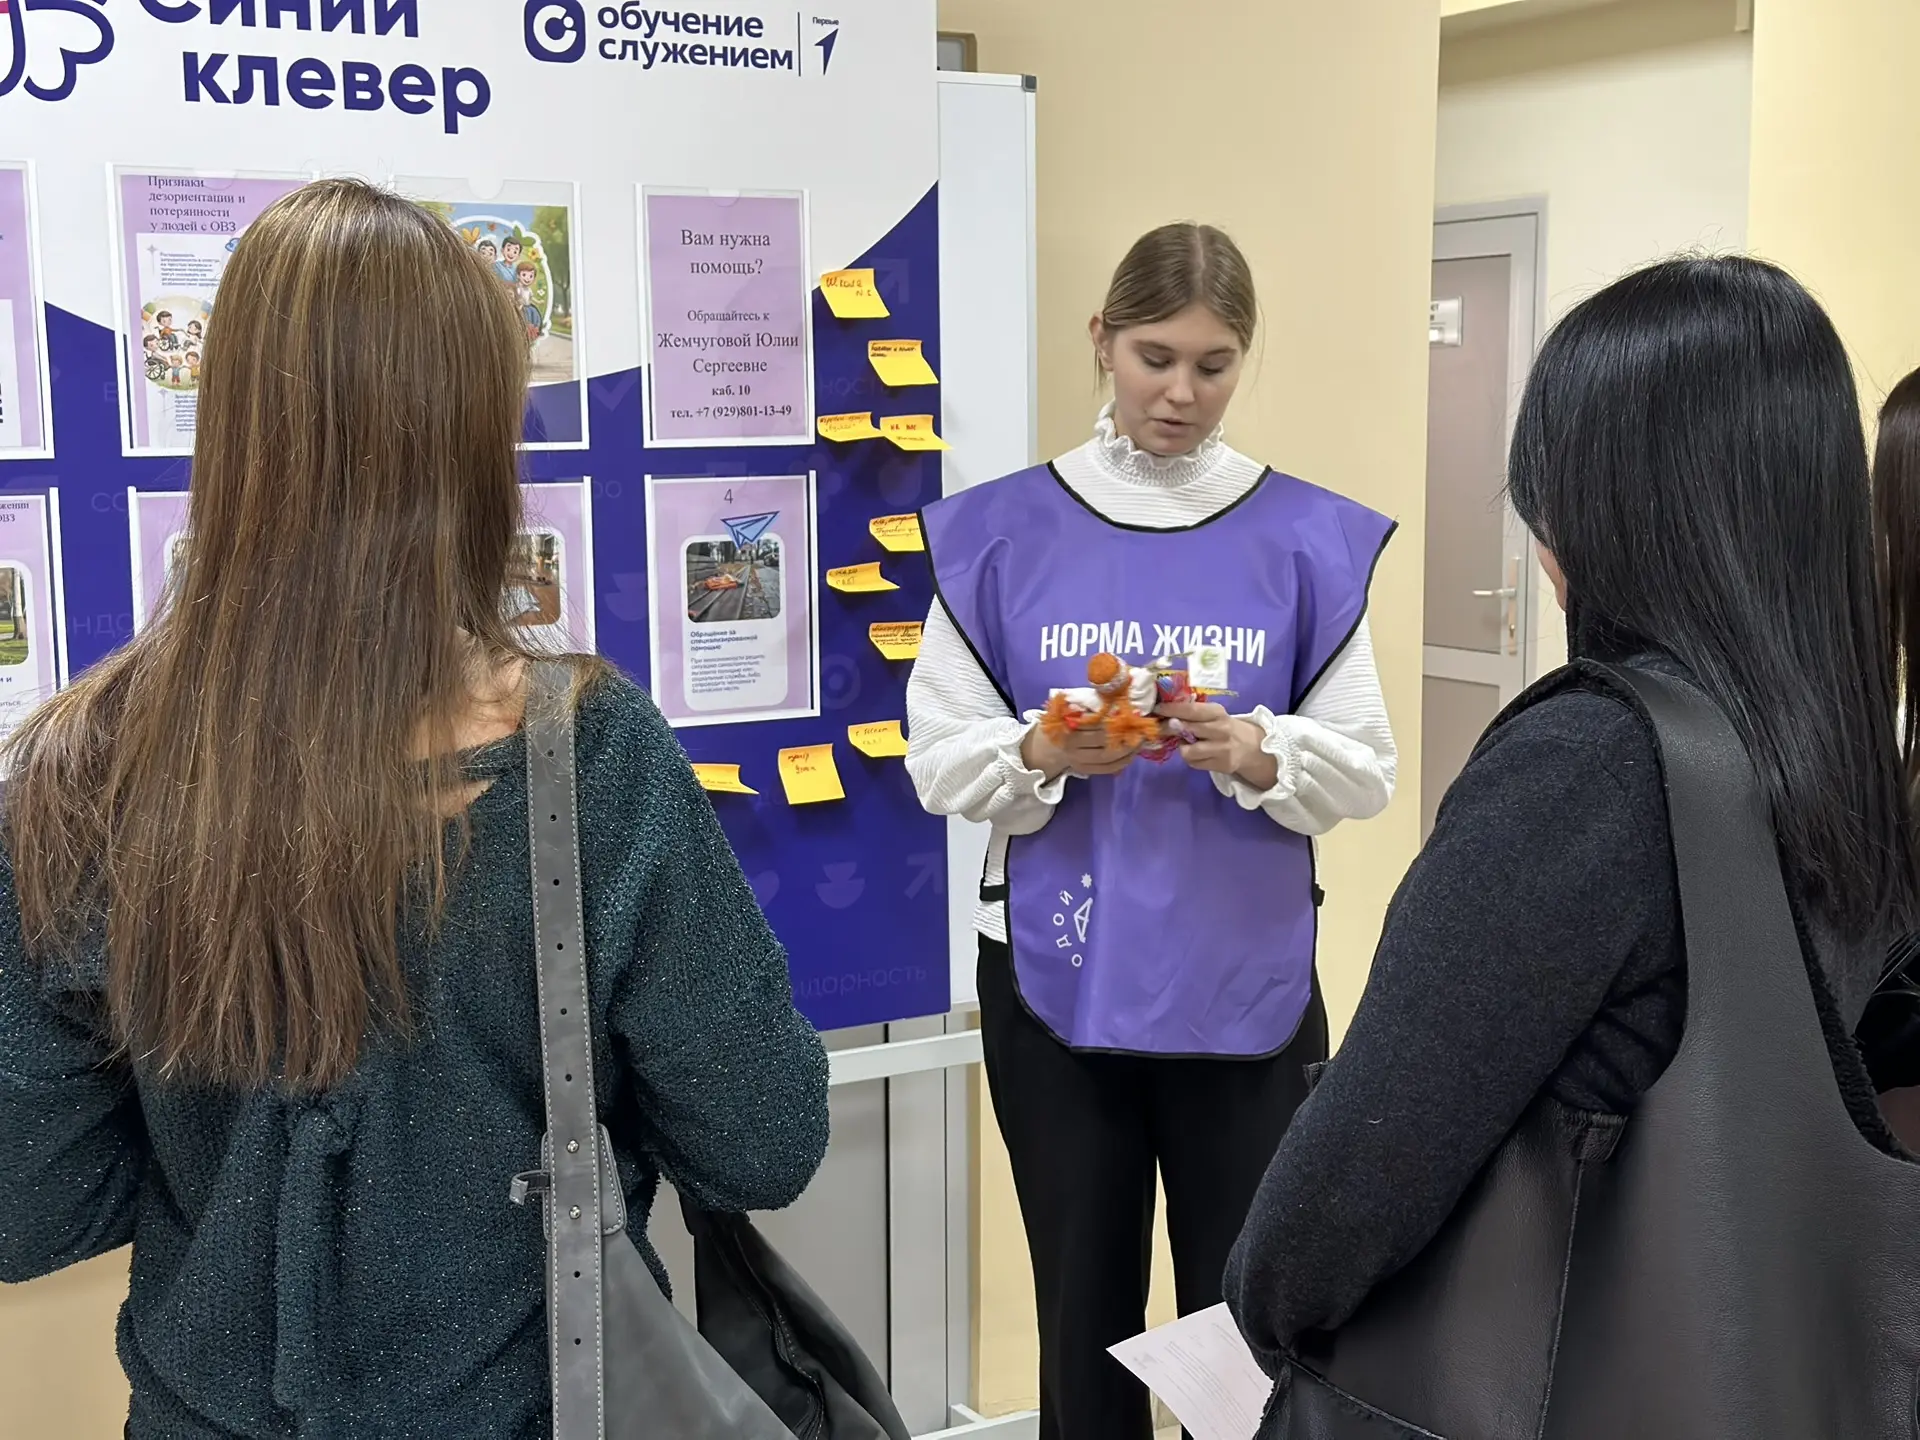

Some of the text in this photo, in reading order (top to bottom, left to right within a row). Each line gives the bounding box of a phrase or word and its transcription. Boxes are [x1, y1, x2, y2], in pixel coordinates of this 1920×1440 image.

[597, 0, 764, 38] обучение
[598, 36, 794, 70] служением
[183, 51, 491, 135] клевер
[147, 175, 204, 189] Признаки
[148, 193, 245, 204] дезориентации и
[149, 207, 230, 218] потерянности
[150, 221, 236, 233] у людей с ОВЗ
[681, 229, 771, 250] Вам нужна
[690, 259, 763, 275] помощь?
[687, 309, 770, 322] Обращайтесь к
[657, 332, 799, 351] Жемчуговой Юлии
[692, 358, 768, 376] Сергеевне
[711, 384, 751, 396] каб. 10
[670, 405, 792, 419] тел. +7 (929)801-13-49
[723, 488, 734, 504] 4
[1040, 620, 1266, 667] НОРМА ЖИЗНИ
